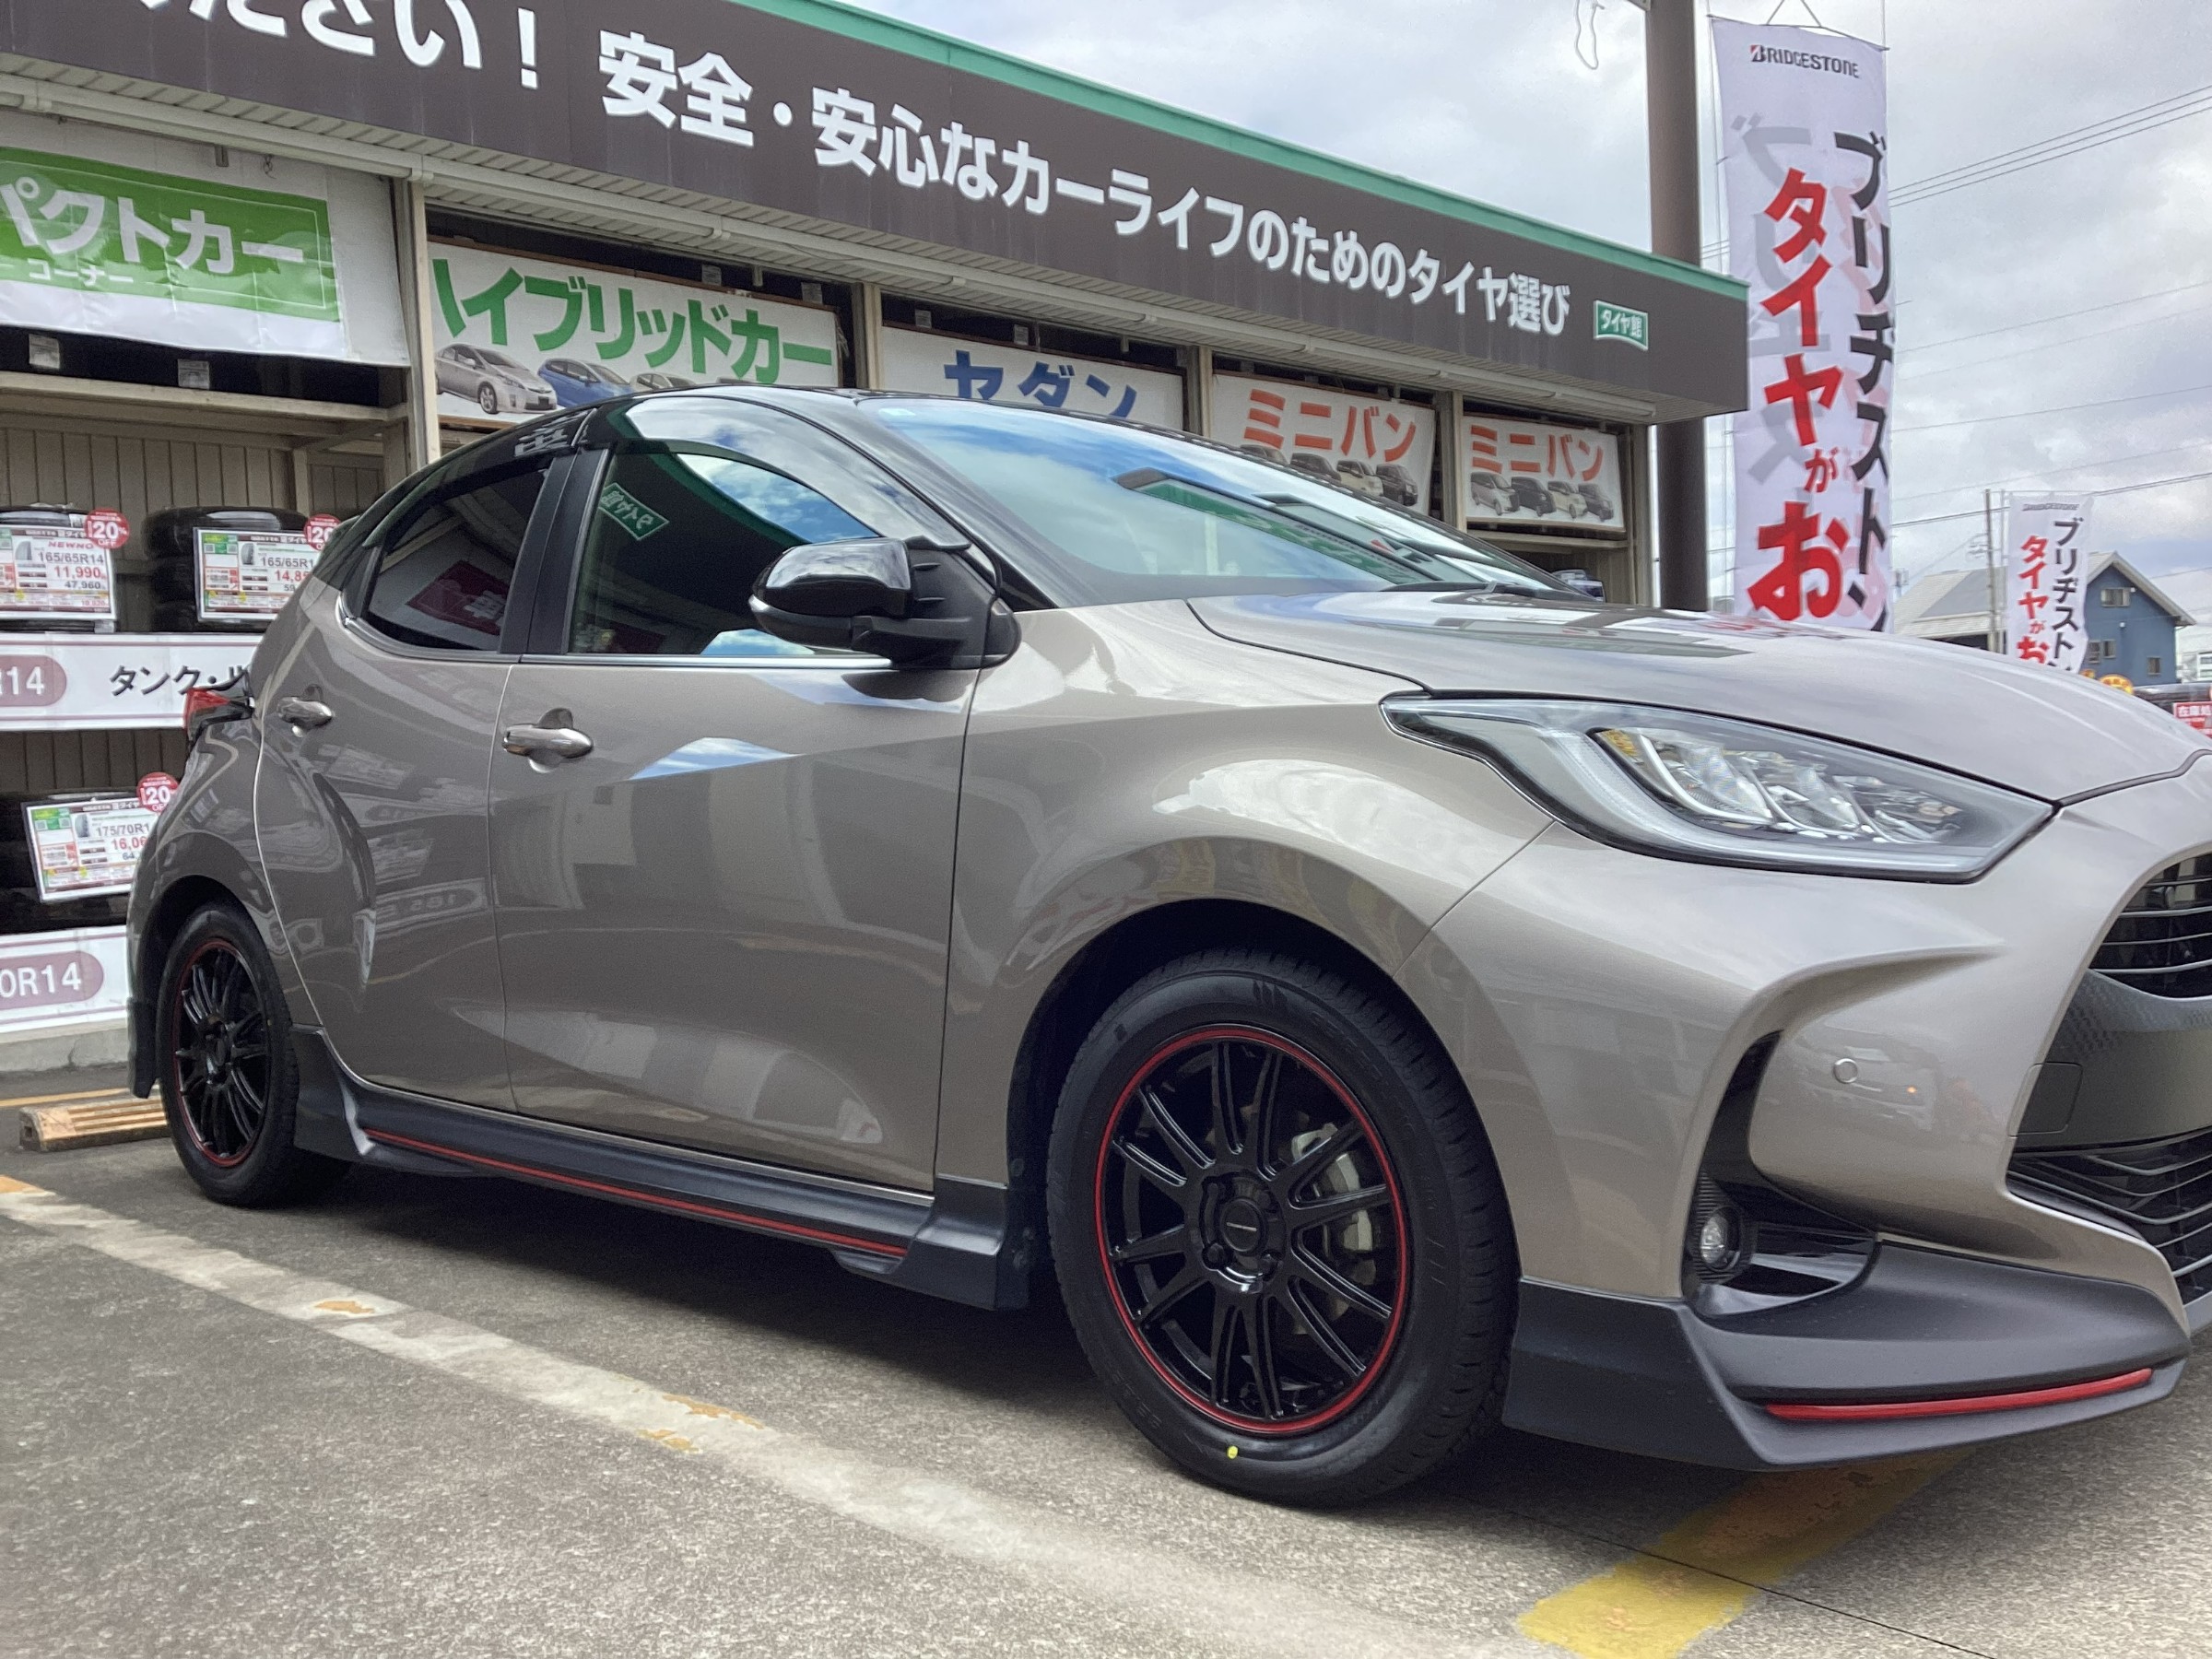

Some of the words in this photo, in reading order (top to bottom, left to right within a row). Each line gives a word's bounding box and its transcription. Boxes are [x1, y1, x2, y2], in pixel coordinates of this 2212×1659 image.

[1749, 44, 1860, 78] BRIDGESTONE
[599, 30, 1570, 335] 安全・安心なカーライフのためのタイヤ選び
[27, 257, 135, 288] コーナー
[1600, 309, 1643, 339] タイヤ館
[1747, 167, 1849, 622] タイヤがお
[1244, 388, 1417, 462] ミニバン
[1470, 425, 1605, 482] ミニバン
[39, 551, 104, 564] 165/65R14
[261, 557, 315, 569] 165/65R1
[2047, 517, 2085, 671] ブリヂスト
[0, 665, 45, 695] 14
[146, 785, 176, 806] 20
[97, 823, 150, 837] 175/70R1
